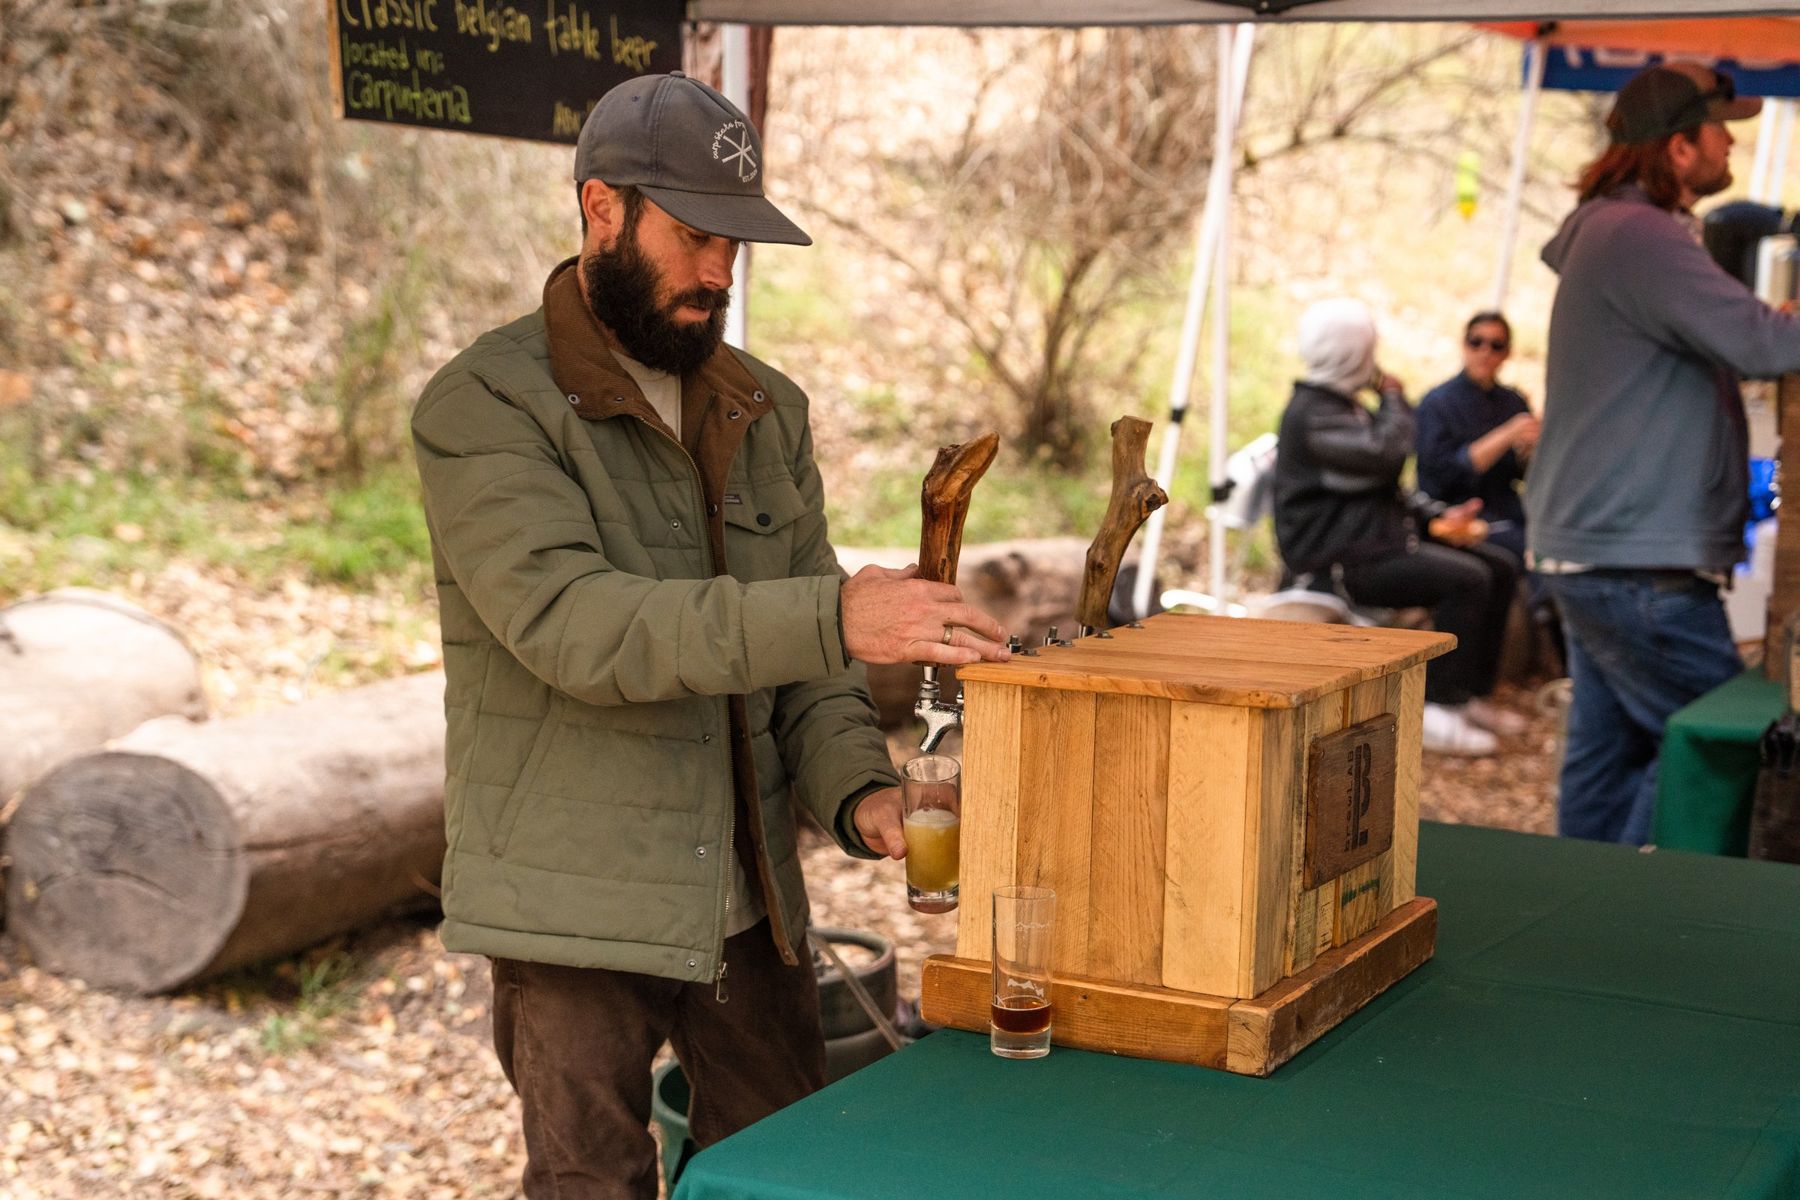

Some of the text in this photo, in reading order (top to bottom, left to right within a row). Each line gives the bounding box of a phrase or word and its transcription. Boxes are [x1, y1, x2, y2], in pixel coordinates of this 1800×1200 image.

[342, 32, 410, 71] located
[544, 0, 601, 61] table
[609, 14, 659, 72] beer
